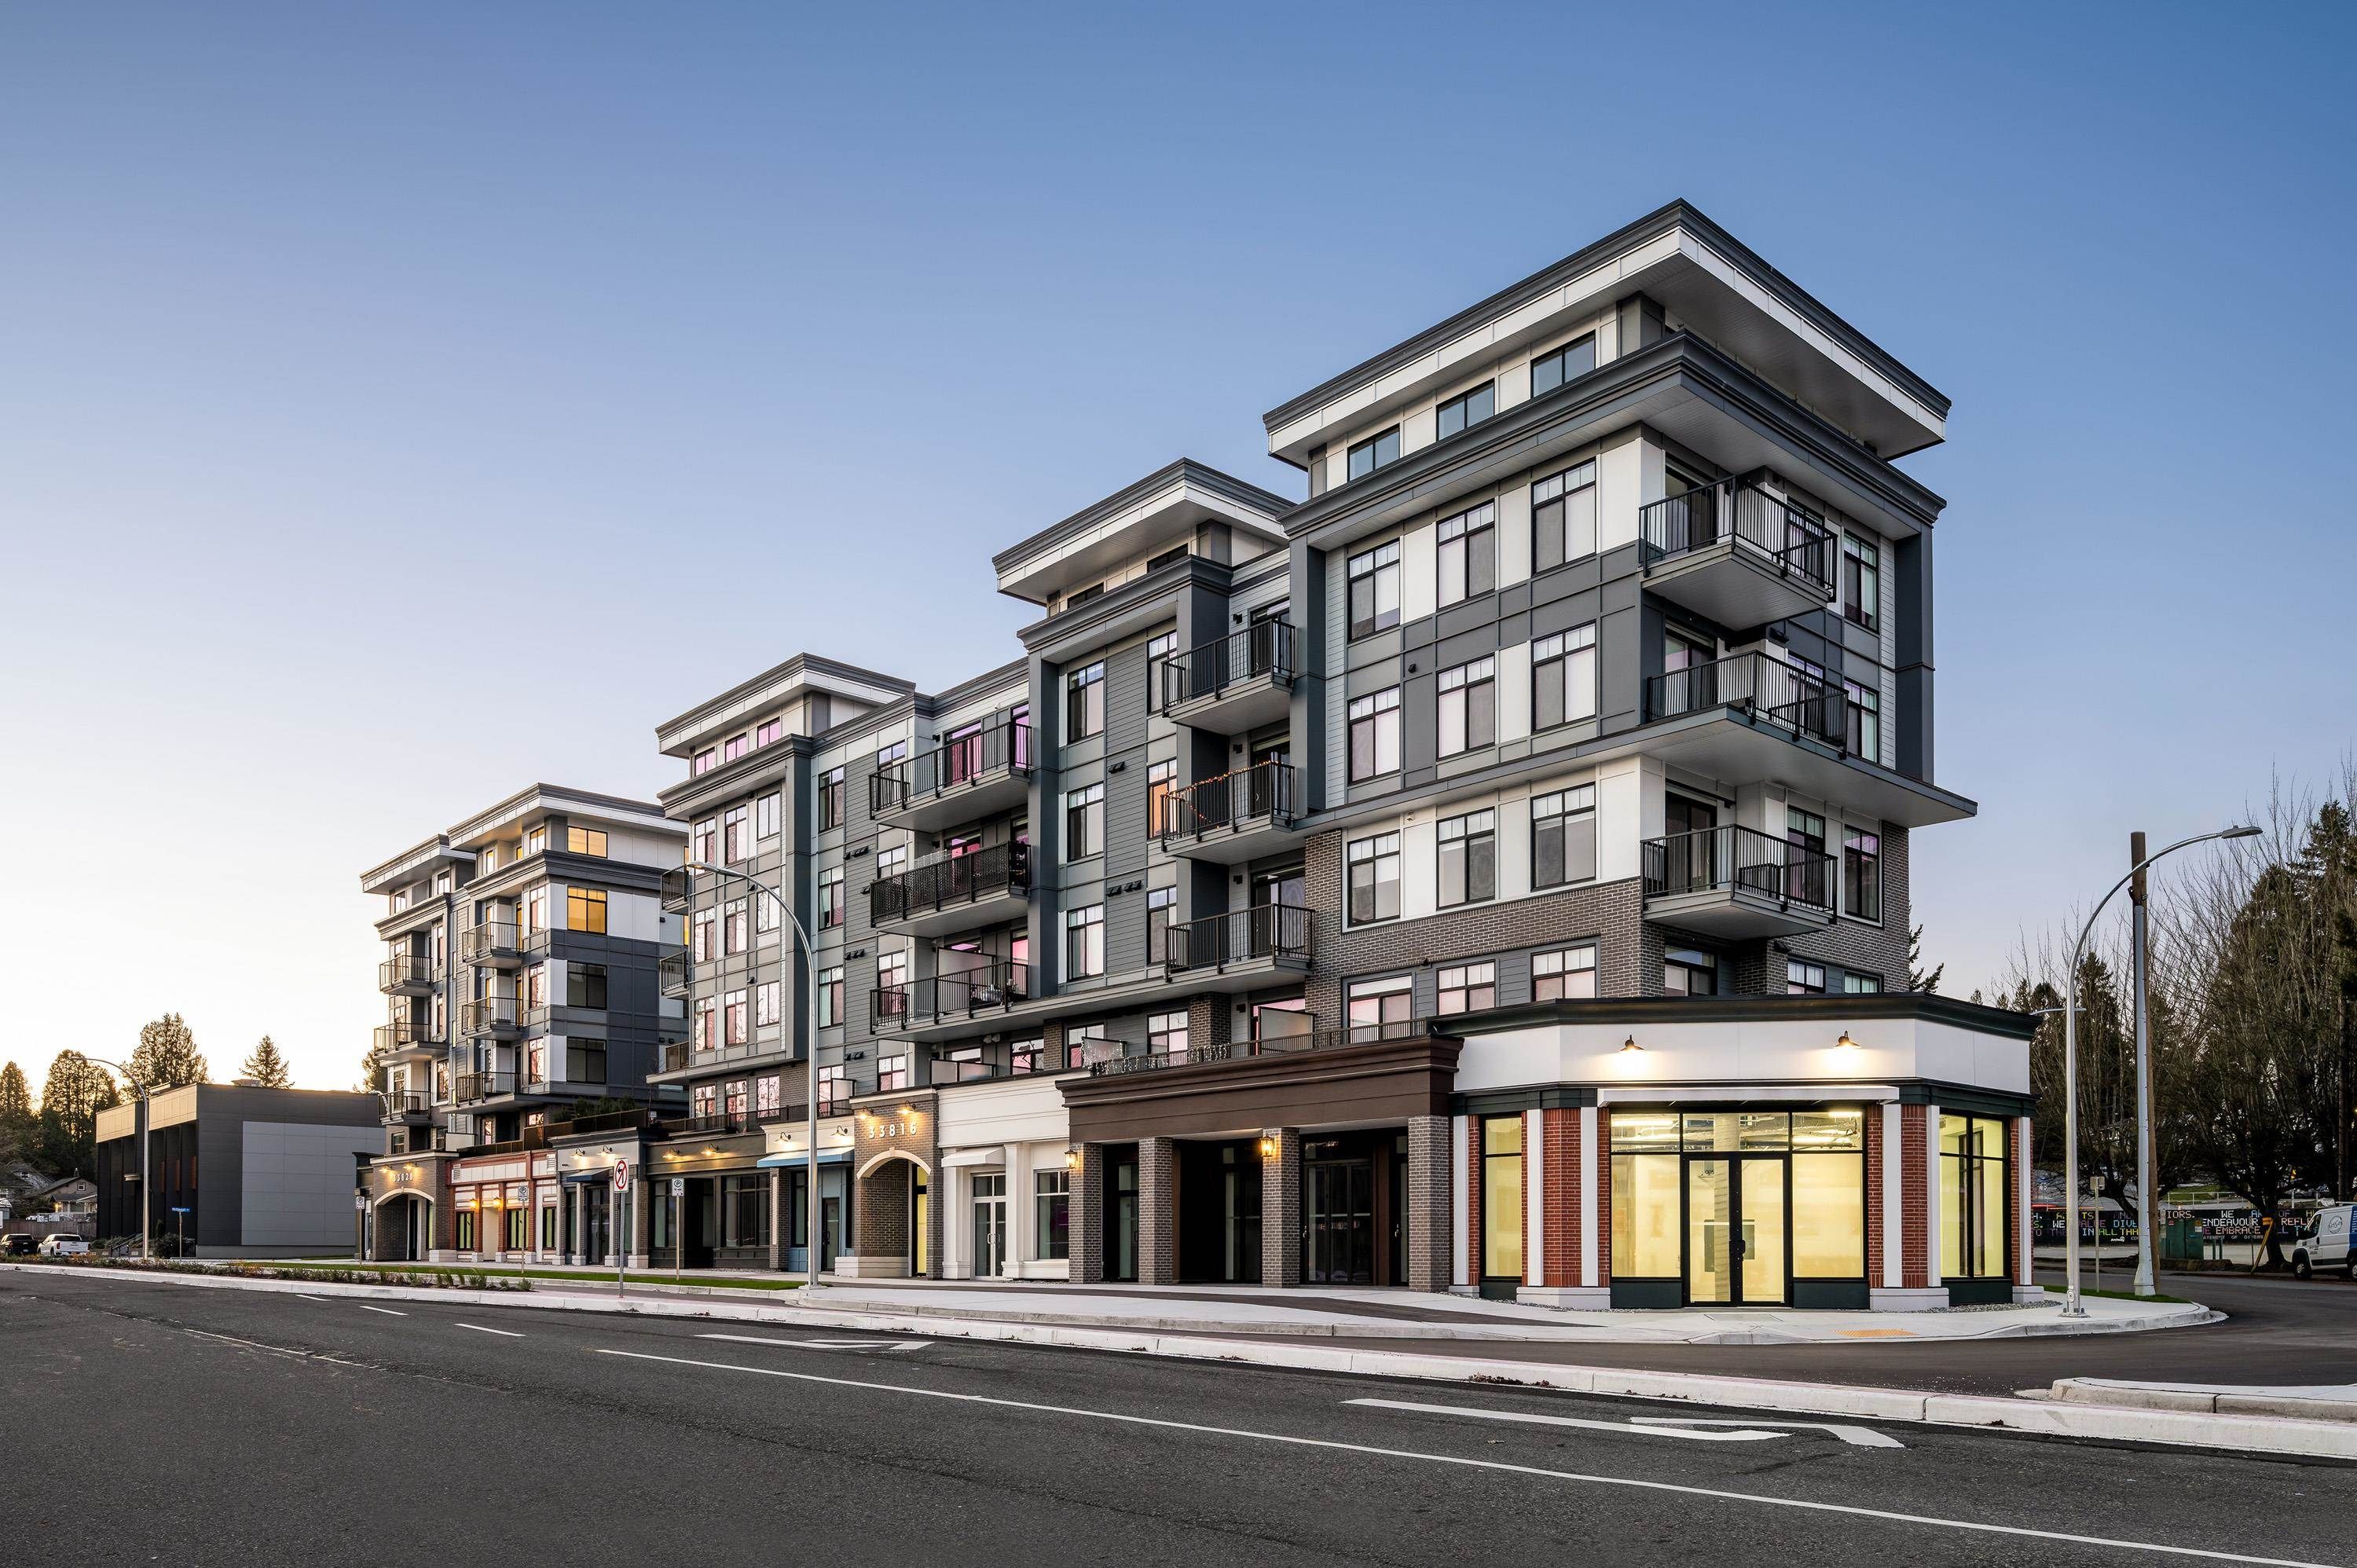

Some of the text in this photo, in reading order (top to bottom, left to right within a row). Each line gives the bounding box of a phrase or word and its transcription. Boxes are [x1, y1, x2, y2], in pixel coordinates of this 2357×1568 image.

[867, 1122, 918, 1139] 33816
[2221, 1210, 2234, 1218] WE
[2052, 1220, 2066, 1229] WE
[2080, 1219, 2106, 1228] ALUE
[2082, 1228, 2095, 1236] IN
